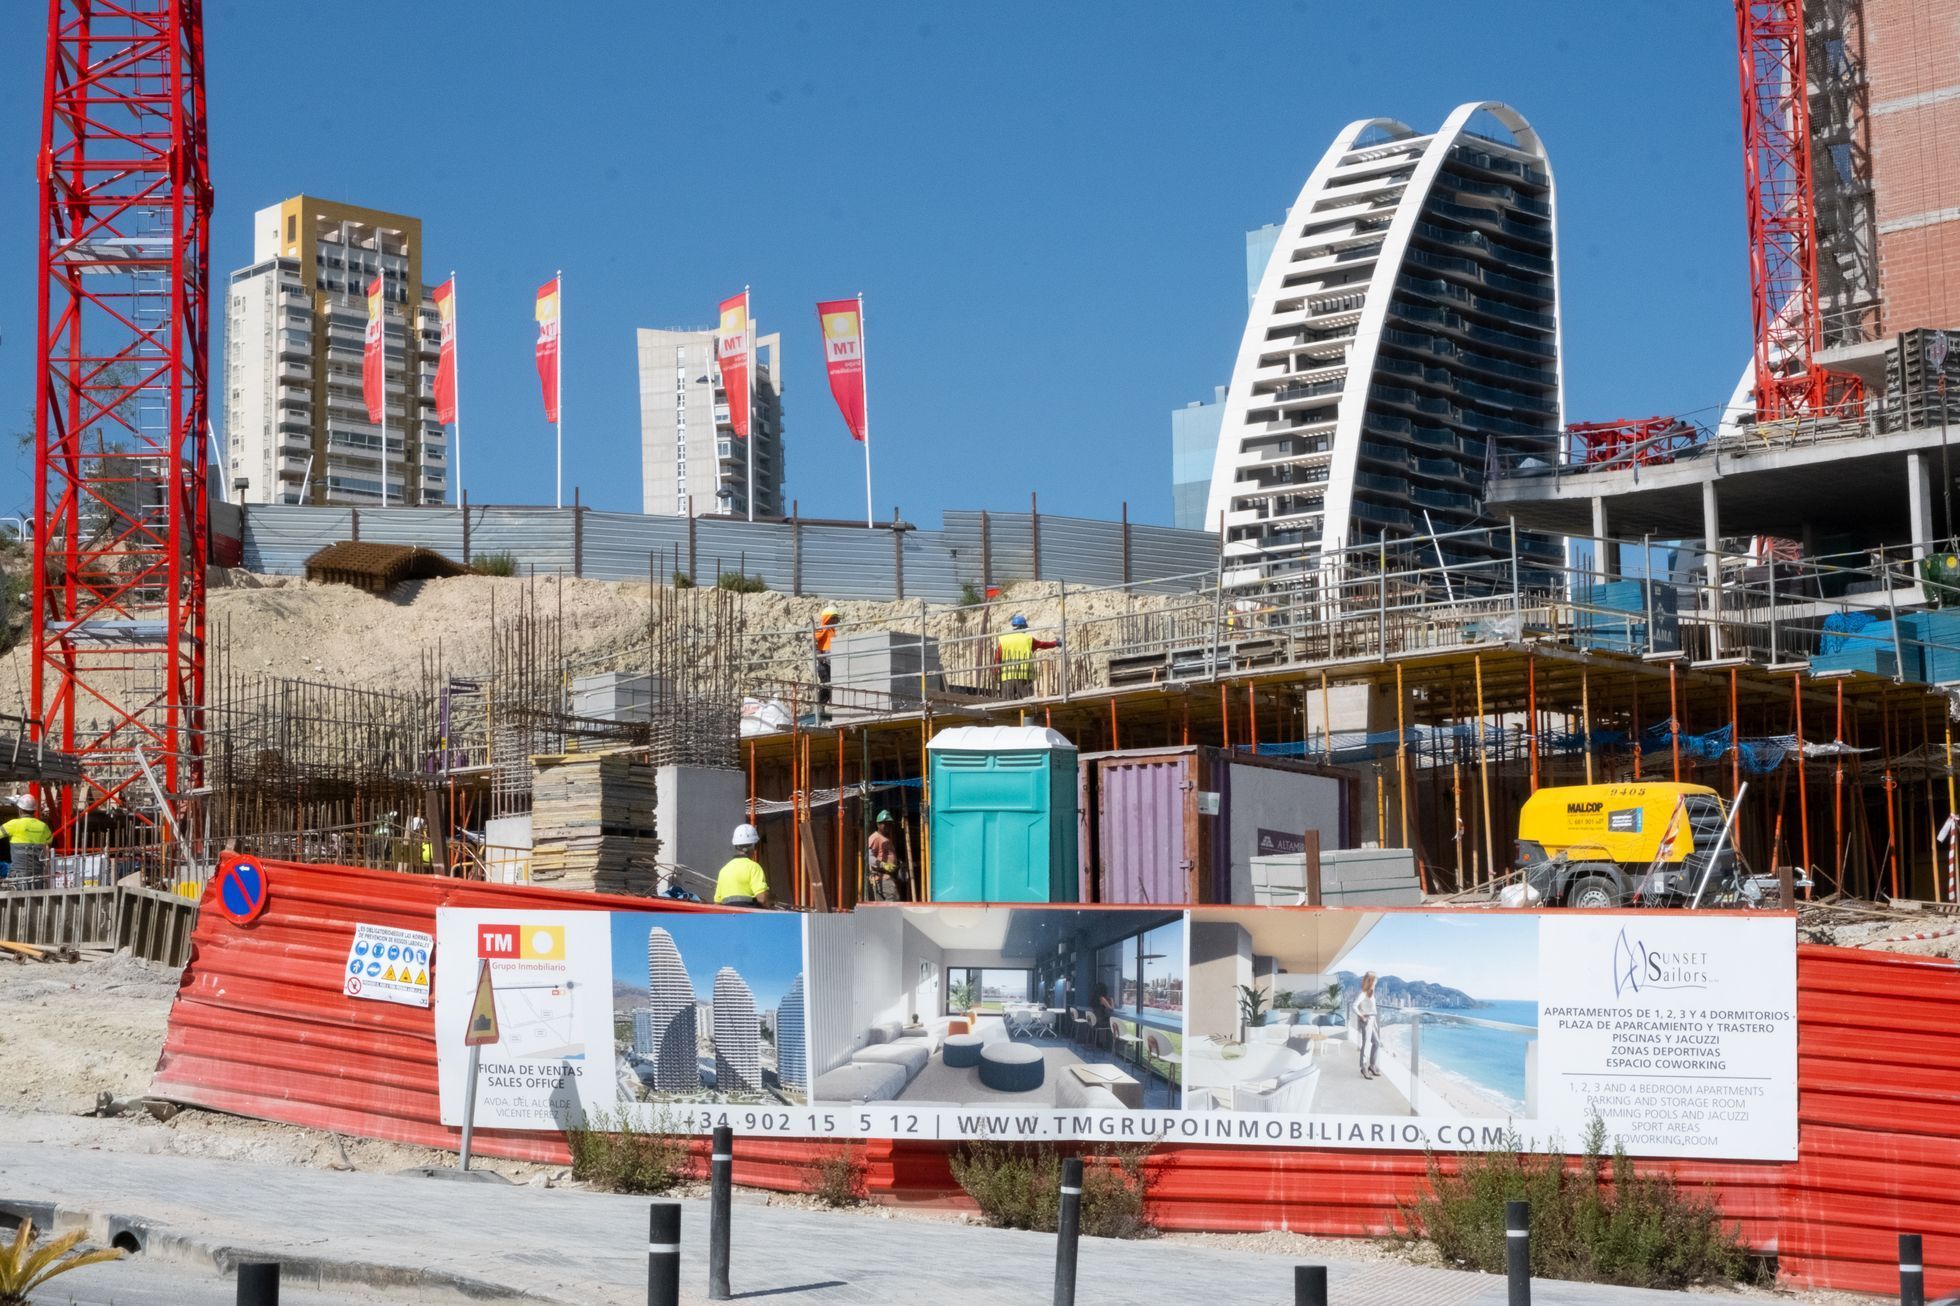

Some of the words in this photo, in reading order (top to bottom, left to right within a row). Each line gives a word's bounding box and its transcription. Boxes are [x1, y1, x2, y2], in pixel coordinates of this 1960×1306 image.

[1653, 628, 1673, 643] ANA
[1610, 787, 1646, 796] 9405
[1567, 802, 1603, 813] MALCOP
[483, 933, 512, 952] TM
[492, 962, 516, 971] Grupo
[518, 962, 566, 972] Inmobiliario
[1544, 1007, 1633, 1018] APARTAMENTOS
[1636, 1009, 1650, 1018] DE
[1655, 1009, 1663, 1019] 1,
[1666, 1010, 1676, 1019] 2,
[1680, 1010, 1686, 1019] 3
[1689, 1010, 1696, 1019] Y
[1700, 1010, 1706, 1019] 4
[1710, 1010, 1790, 1021] DORMITORIOS
[1559, 1020, 1593, 1029] PLAZA
[1597, 1021, 1611, 1030] DE
[1615, 1021, 1703, 1031] APARCAMIENTO
[1706, 1023, 1714, 1031] Y
[1717, 1023, 1774, 1033] TRASTERO
[1612, 1033, 1661, 1043] PISCINAS
[1665, 1035, 1672, 1043] Y
[1675, 1035, 1720, 1044] JACUZZI
[1611, 1045, 1649, 1056] ZONAS
[1653, 1047, 1721, 1057] DEPORTIVAS
[478, 1063, 515, 1075] FICINA
[519, 1065, 533, 1076] DE
[538, 1065, 583, 1077] VENTAS
[1606, 1058, 1651, 1068] ESPACIO
[1655, 1060, 1726, 1070] COWORKING
[488, 1077, 522, 1088] SALES
[526, 1078, 565, 1089] OFFICE
[1570, 1082, 1577, 1092] 1,
[1581, 1083, 1590, 1093] 2,
[1594, 1083, 1600, 1092] 3
[1604, 1083, 1626, 1093] AND
[1629, 1084, 1636, 1093] 4
[1639, 1084, 1692, 1095] BEDROOM
[1695, 1085, 1764, 1096] APARTMENTS
[484, 1097, 510, 1106] AVDA.
[513, 1098, 528, 1107] DEL
[532, 1099, 571, 1109] ALCALDE
[1587, 1095, 1631, 1106] PARKING
[1634, 1097, 1657, 1106] AND
[1660, 1097, 1709, 1107] STORAGE
[1712, 1098, 1745, 1108] ROOM
[496, 1108, 531, 1118] VICENTE
[1583, 1108, 1641, 1118] SWIMMING
[1645, 1109, 1678, 1119] POOLS
[1681, 1110, 1704, 1120] AND
[1708, 1111, 1749, 1121] JACUZZI
[745, 1112, 790, 1131] 902
[807, 1114, 835, 1132] 15
[890, 1114, 918, 1133] 12
[958, 1115, 1503, 1146] WWW.TMGRUPOINMOBILIARIO.COM
[1632, 1121, 1664, 1131] SPORT
[1667, 1122, 1701, 1132] AREAS
[1684, 1135, 1718, 1146] ROOM
